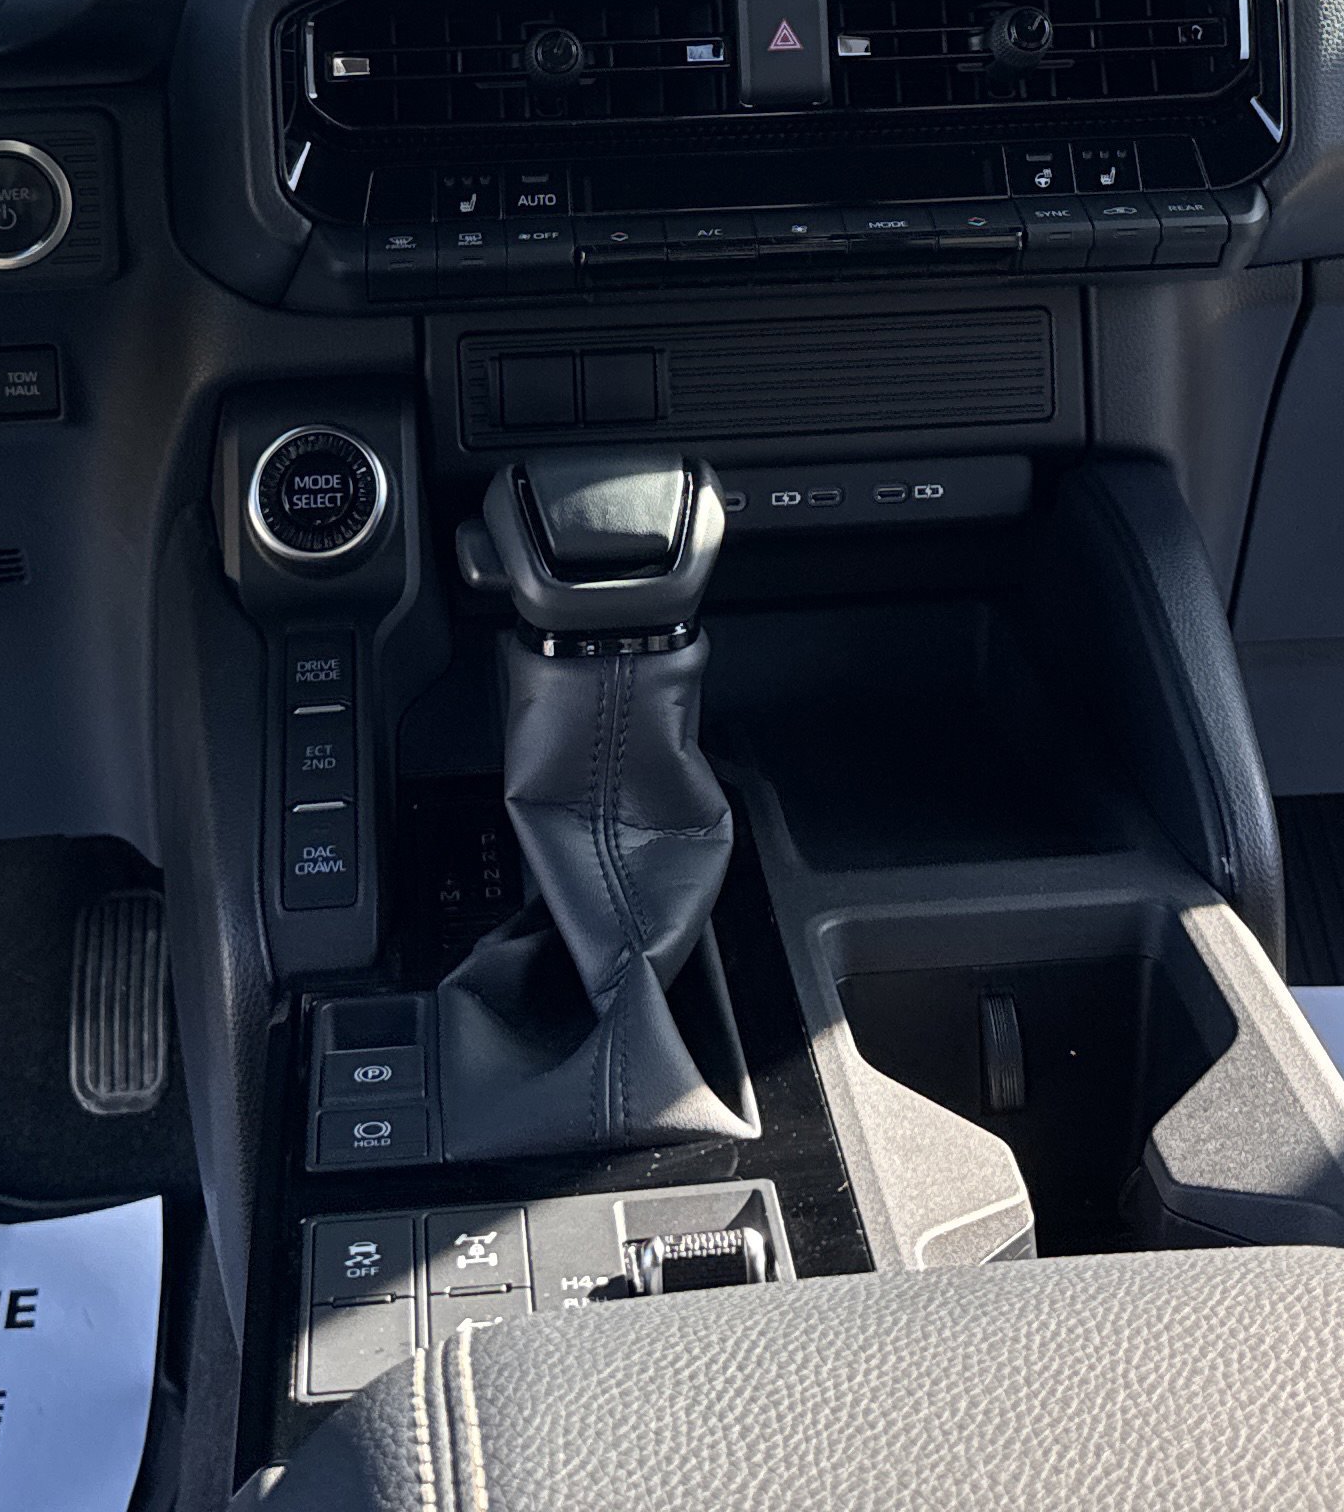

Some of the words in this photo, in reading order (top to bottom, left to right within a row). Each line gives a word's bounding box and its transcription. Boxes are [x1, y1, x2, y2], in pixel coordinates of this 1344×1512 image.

[518, 193, 556, 207] AUTO
[1035, 208, 1071, 218] SYNC
[1168, 203, 1205, 213] REAR
[868, 219, 908, 229] MODE
[533, 231, 559, 240] OFF
[697, 228, 723, 237] A/C
[7, 370, 38, 383] TOW
[4, 383, 40, 397] HAUL
[294, 474, 342, 490] MODE
[292, 492, 344, 509] SELECT
[296, 658, 341, 672] DRIVE
[296, 670, 341, 683] MODE
[305, 744, 333, 757] ECT
[301, 757, 337, 771] 2ND
[303, 845, 337, 859] DAC
[295, 859, 346, 875] CRAWL
[354, 1138, 391, 1148] HOLD
[346, 1266, 380, 1279] OFF
